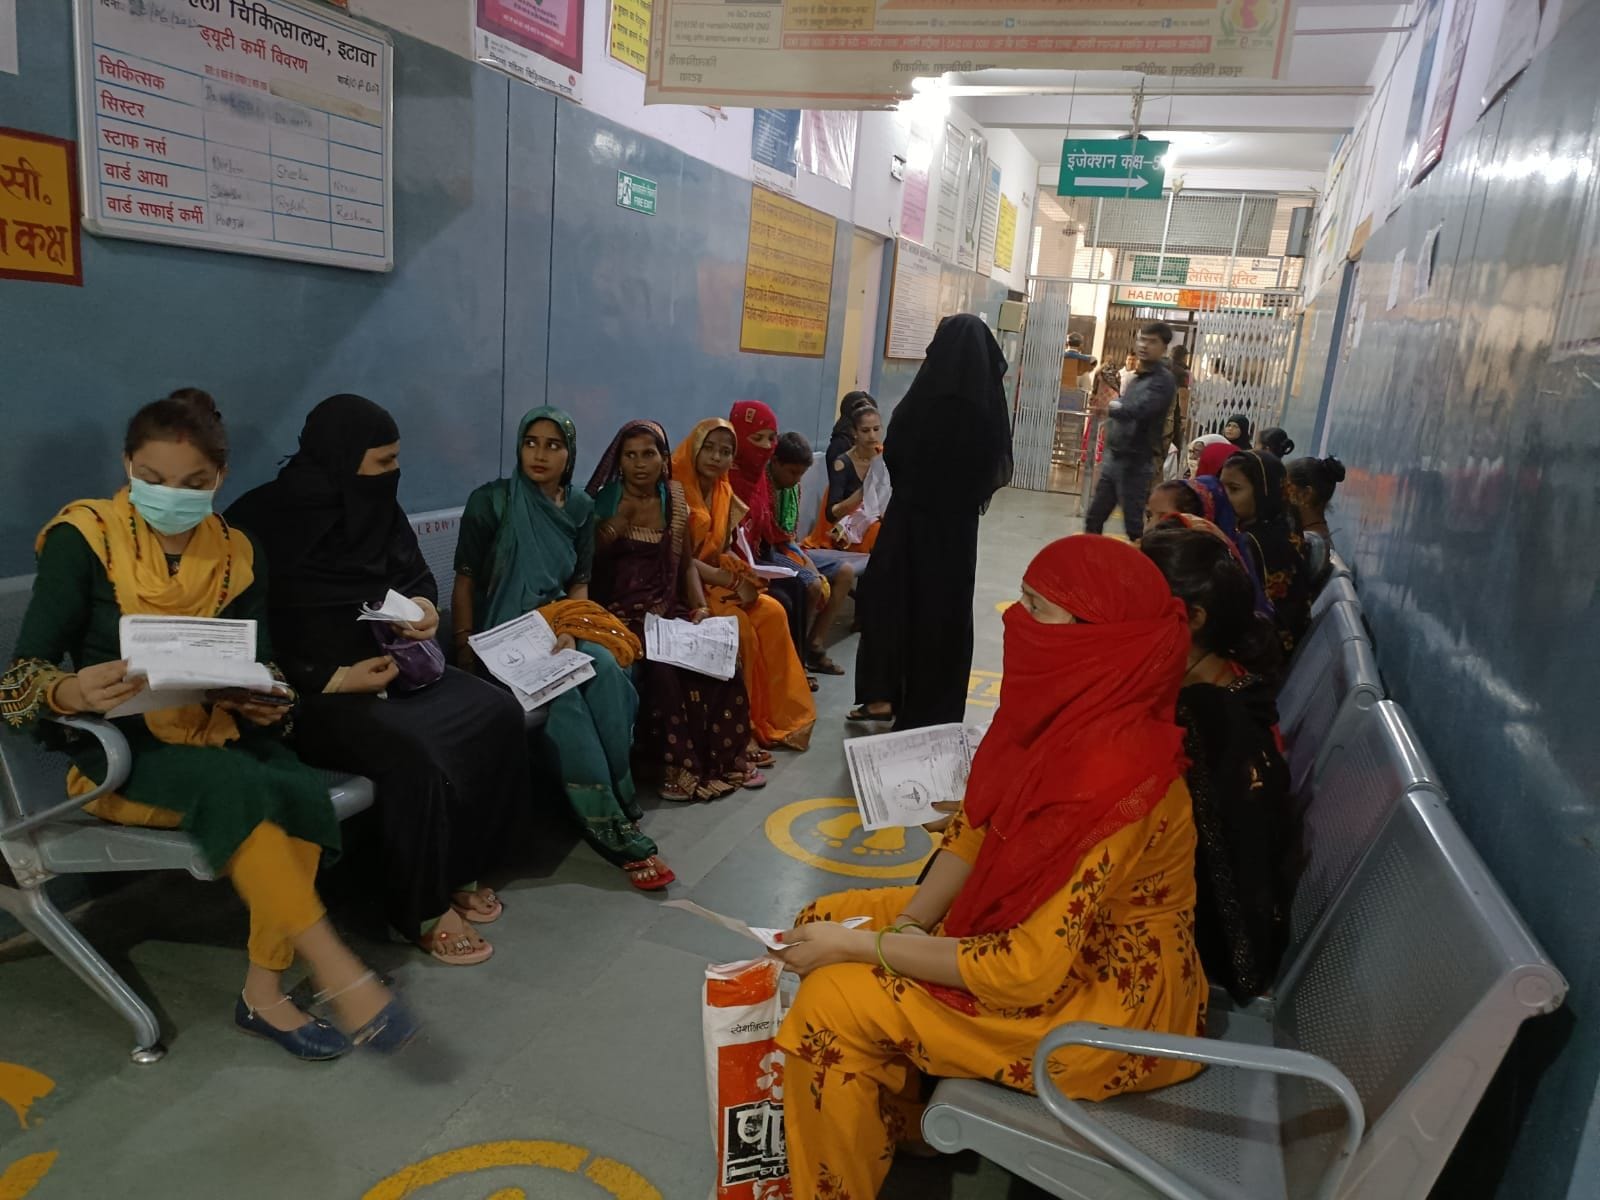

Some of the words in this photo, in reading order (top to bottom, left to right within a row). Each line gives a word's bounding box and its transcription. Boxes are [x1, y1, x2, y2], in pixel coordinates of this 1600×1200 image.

[240, 38, 267, 61] कर्मी
[270, 44, 309, 74] विवरण
[337, 40, 377, 68] इटावा
[98, 54, 166, 91] चिकित्सक
[100, 89, 145, 118] सिस्टर
[101, 128, 140, 150] स्टाफ
[143, 136, 167, 157] नर्स
[103, 161, 133, 182] वार्ड
[136, 169, 168, 188] आया
[1066, 148, 1118, 172] इंजेक्शन
[106, 194, 133, 215] वार्ड
[136, 201, 175, 224] सफाई
[178, 205, 204, 225] कर्मी
